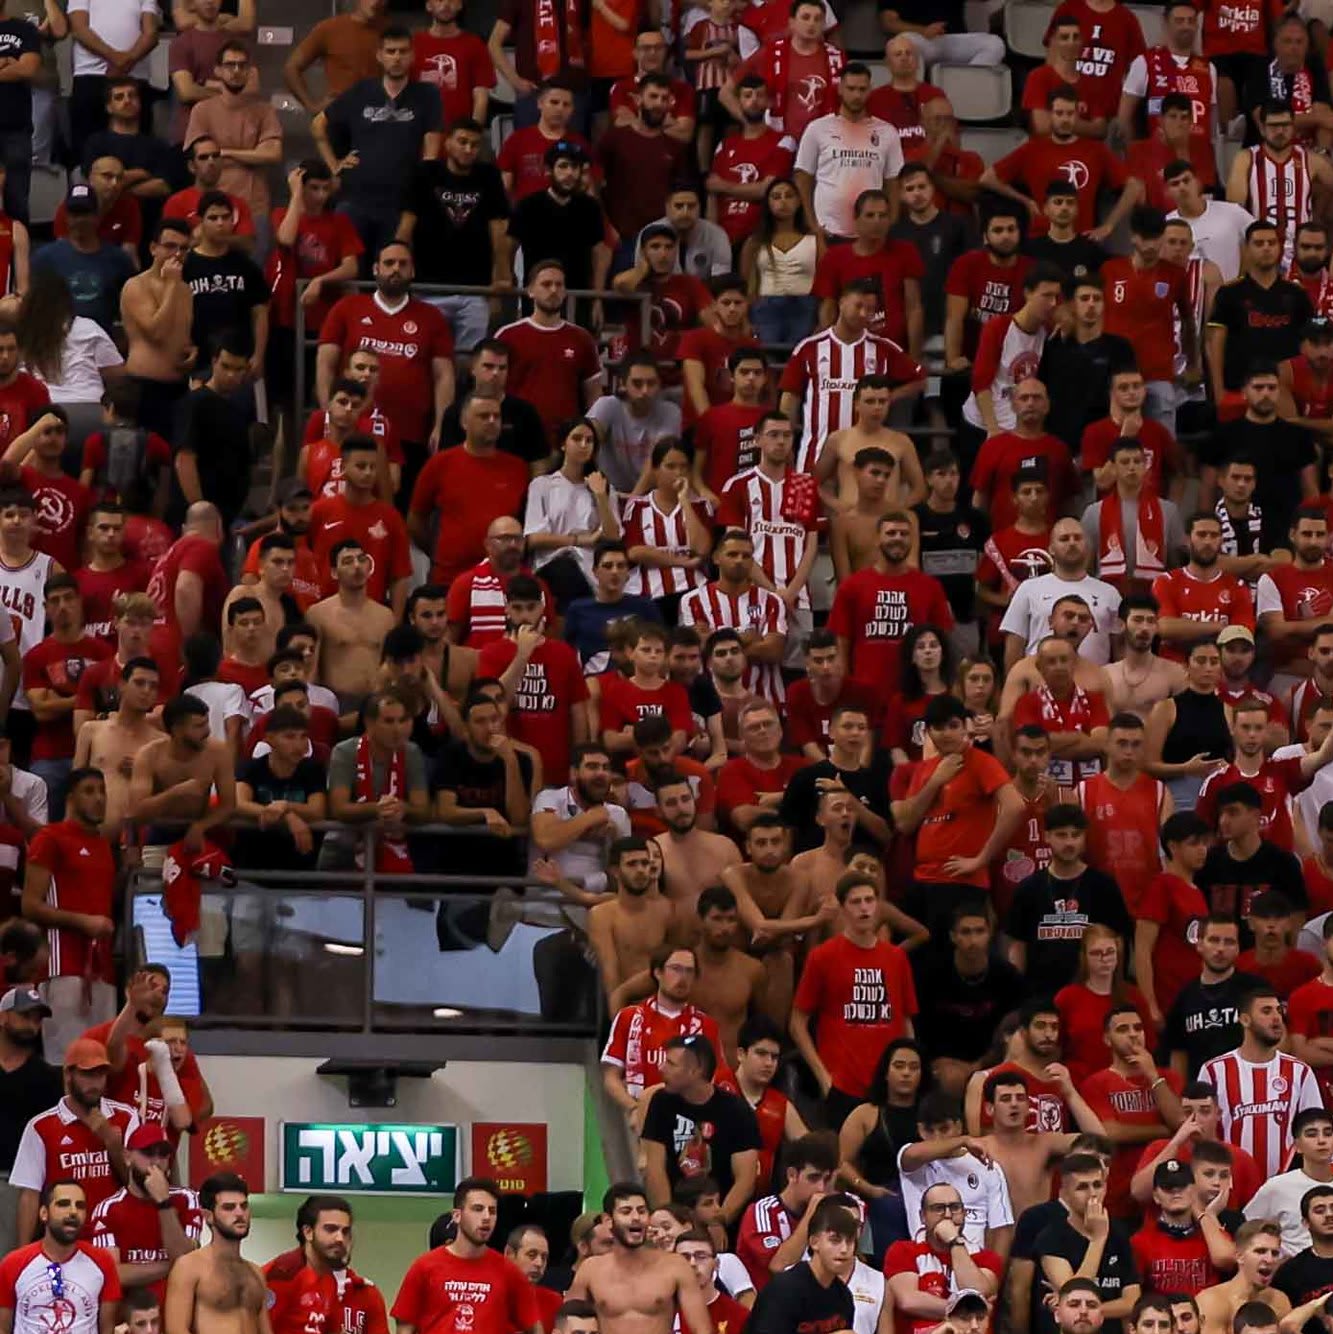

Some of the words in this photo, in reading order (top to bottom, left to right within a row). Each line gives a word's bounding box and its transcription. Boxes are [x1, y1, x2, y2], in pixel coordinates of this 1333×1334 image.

[876, 590, 906, 603] אהבה
[875, 603, 908, 619] לעולם
[854, 967, 883, 984] אהבה
[852, 984, 886, 1002] לעולם
[844, 1003, 876, 1019] נכשלת
[299, 1131, 444, 1186] יציאה
[1101, 1277, 1121, 1289] AIR
